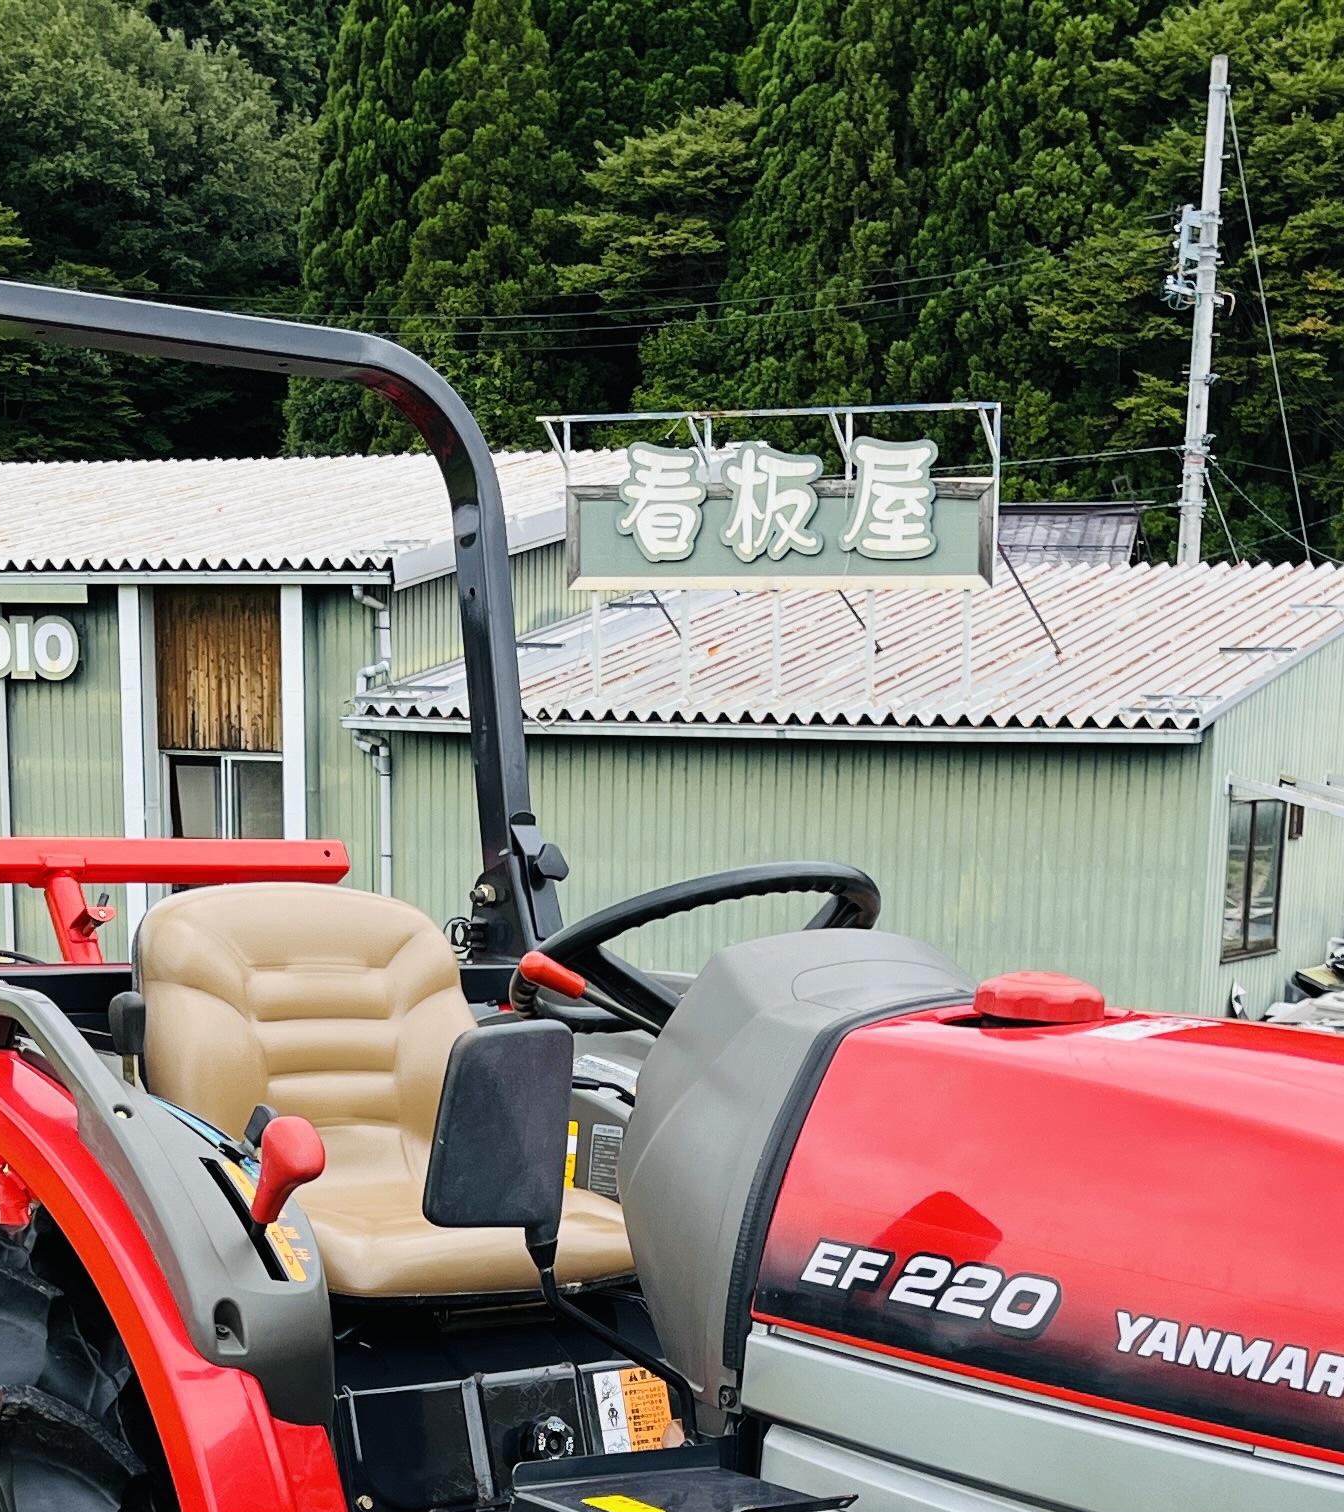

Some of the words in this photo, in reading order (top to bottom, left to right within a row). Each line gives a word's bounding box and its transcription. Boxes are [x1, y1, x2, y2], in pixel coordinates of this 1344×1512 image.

[621, 443, 935, 556] 看板屋
[801, 1241, 889, 1290] EF
[889, 1255, 1060, 1331] 220
